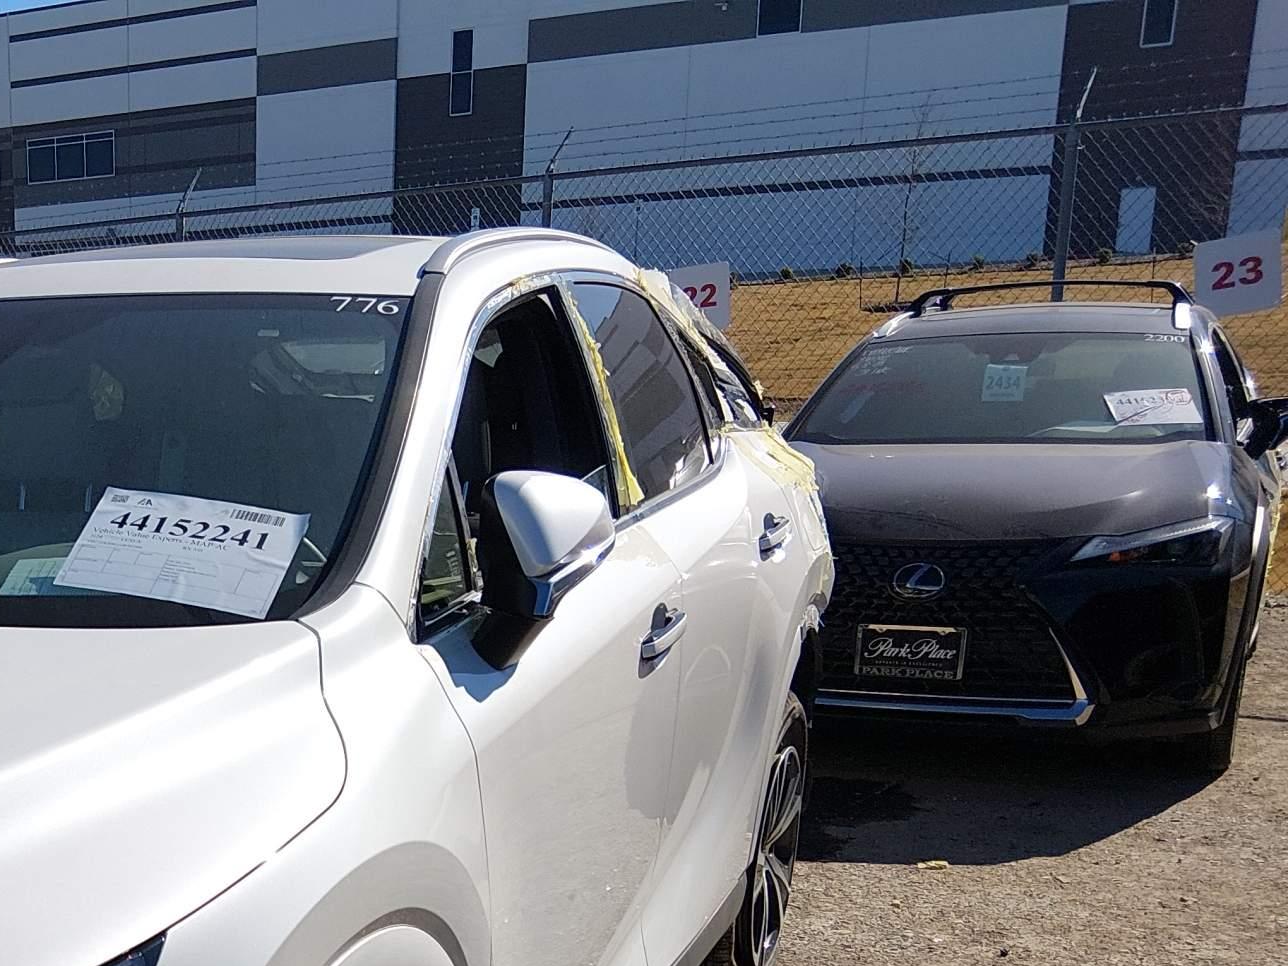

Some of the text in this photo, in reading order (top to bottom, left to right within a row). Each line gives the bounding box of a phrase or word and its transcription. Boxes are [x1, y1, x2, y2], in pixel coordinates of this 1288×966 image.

[1212, 256, 1263, 290] 23
[330, 296, 400, 315] 776
[683, 284, 717, 308] 22
[1144, 334, 1185, 343] 2200
[985, 375, 1020, 391] 2434
[93, 527, 124, 536] Vehicle
[126, 530, 150, 539] Value
[110, 511, 270, 551] 44152241
[864, 637, 957, 660] Park Place
[862, 666, 954, 680] PARK PLACE
